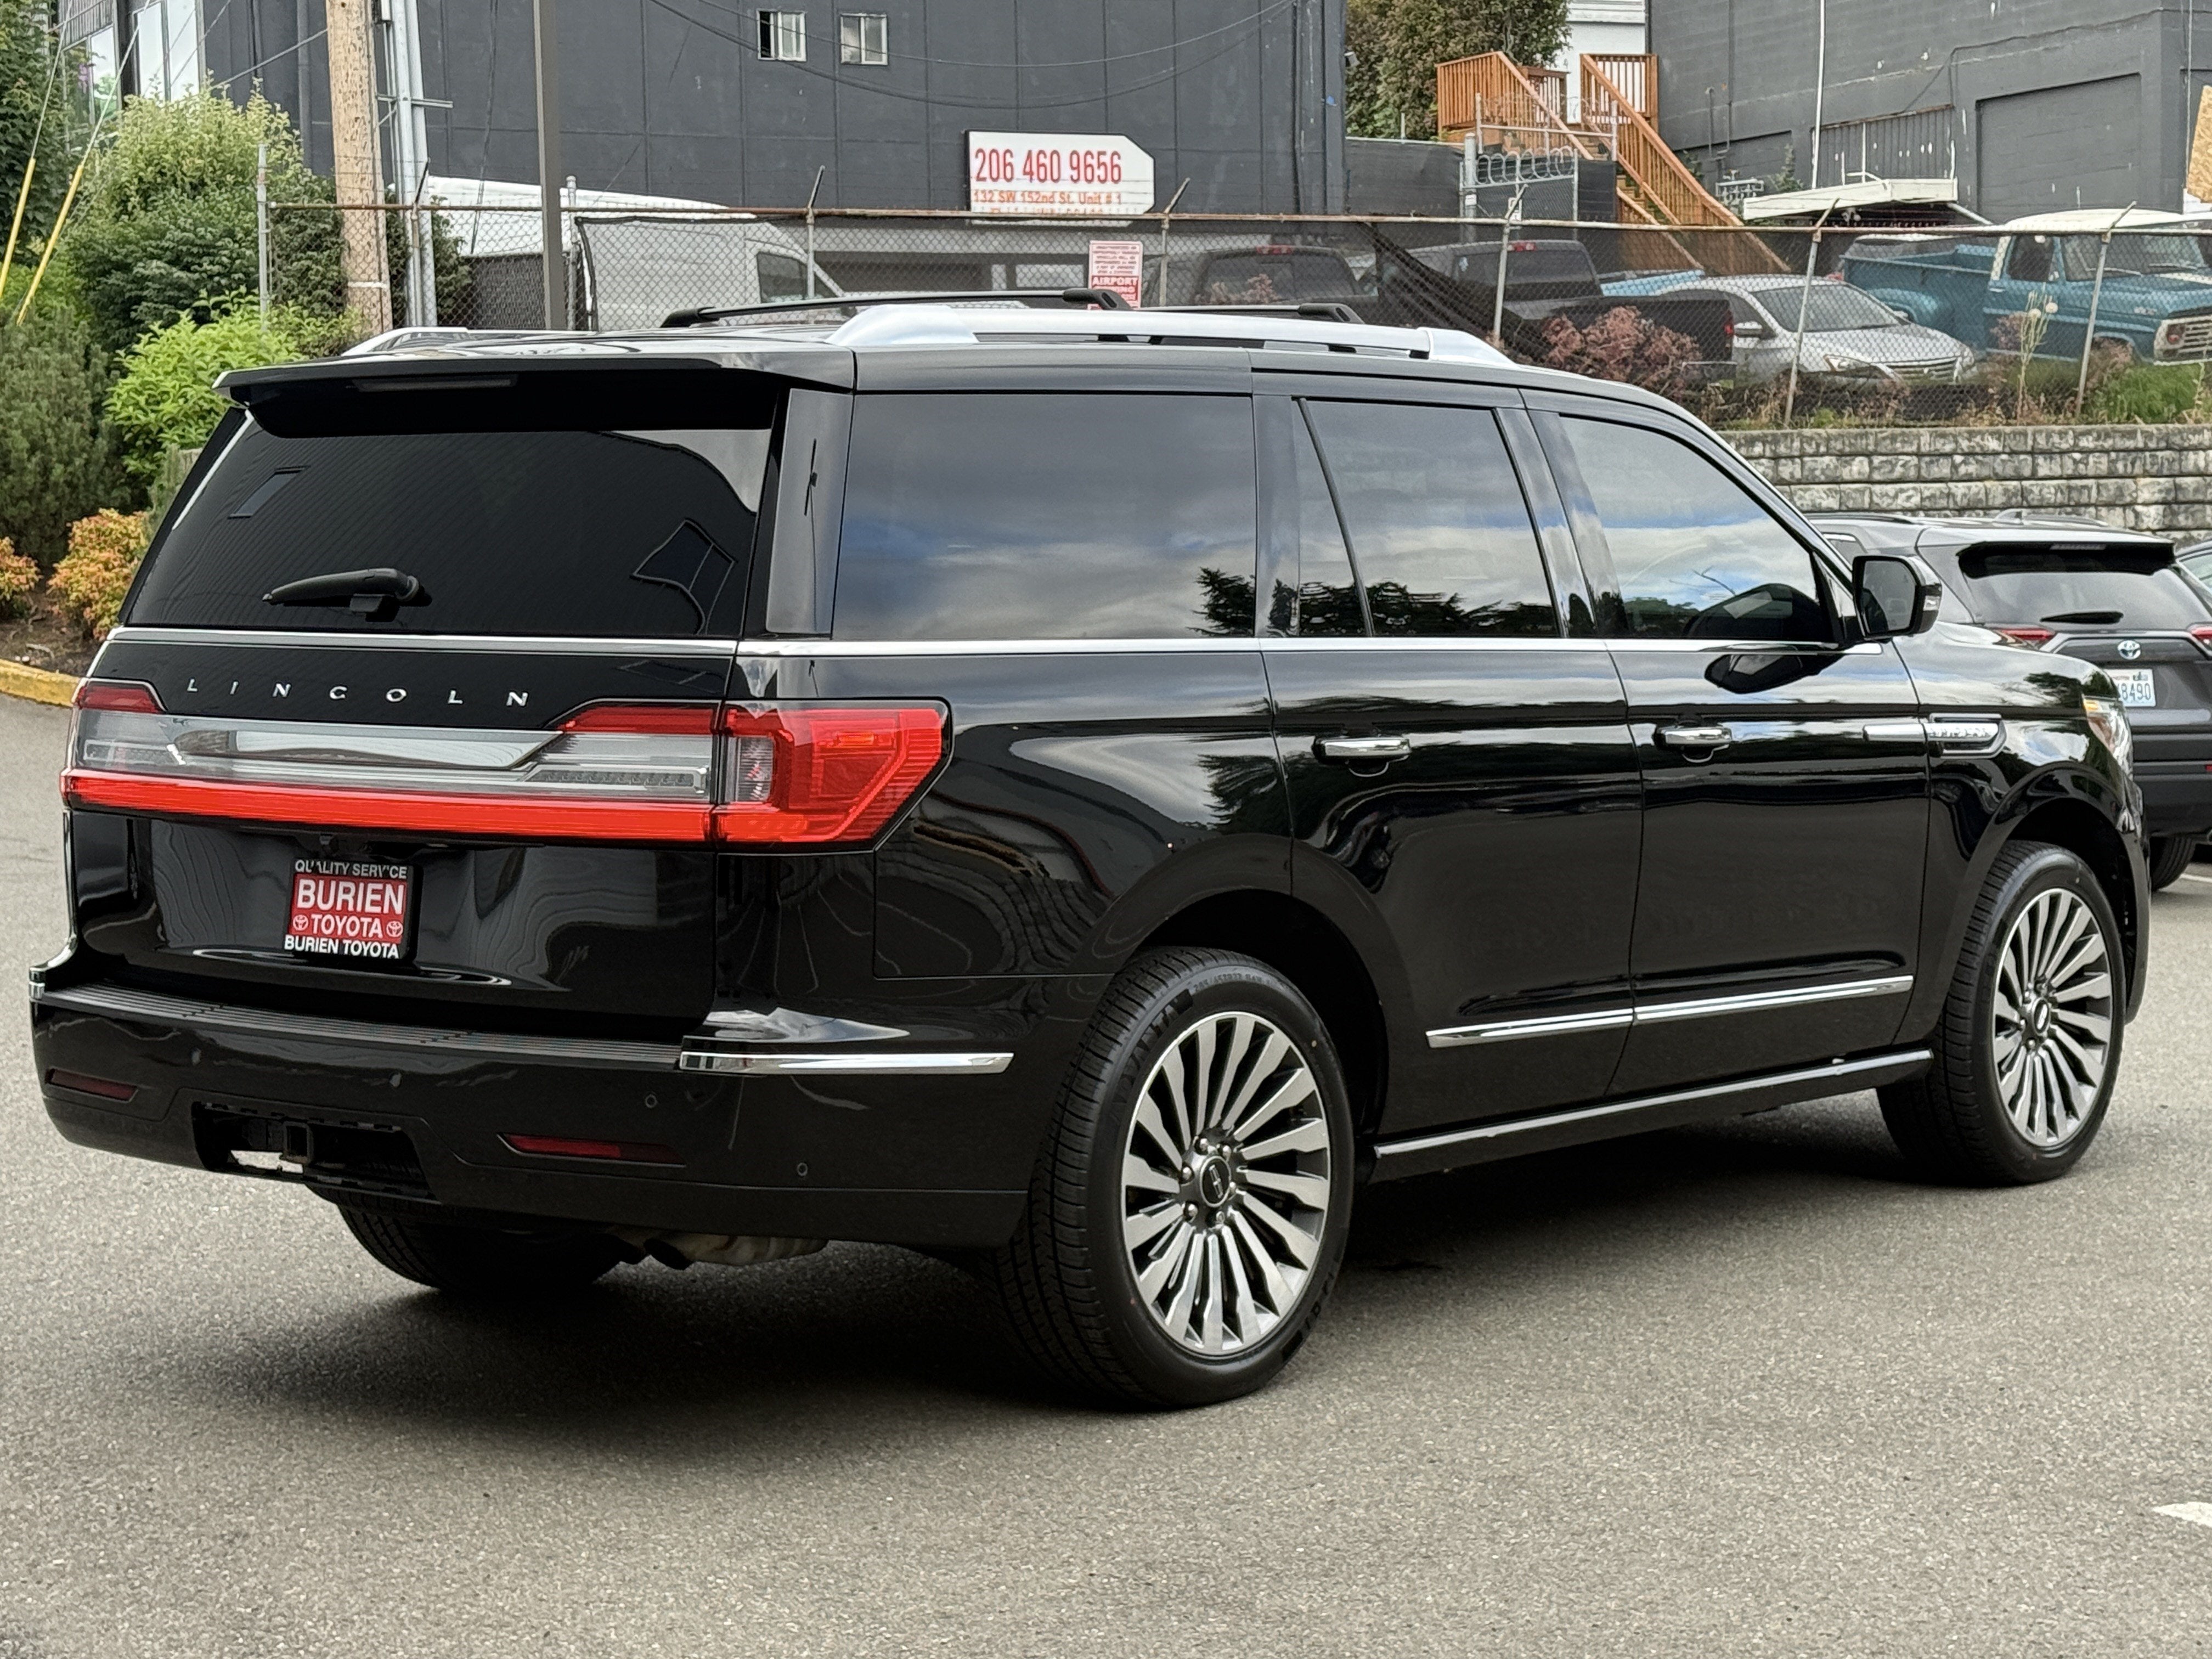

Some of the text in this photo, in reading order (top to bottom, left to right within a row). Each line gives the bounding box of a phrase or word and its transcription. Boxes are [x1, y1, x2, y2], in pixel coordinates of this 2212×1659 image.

[975, 148, 1121, 184] 206 460 9656
[974, 189, 996, 202] 132
[998, 190, 1016, 203] SW
[1021, 190, 1054, 204] 152nd
[1079, 192, 1102, 205] Unit
[1092, 276, 1138, 286] AIRPORT
[187, 678, 528, 707] LINCOLN
[352, 863, 408, 879] SERVCE
[297, 879, 405, 915] BURIEN
[311, 913, 383, 939] TOYOTA
[284, 934, 399, 959] BURIEN TOYOTA
